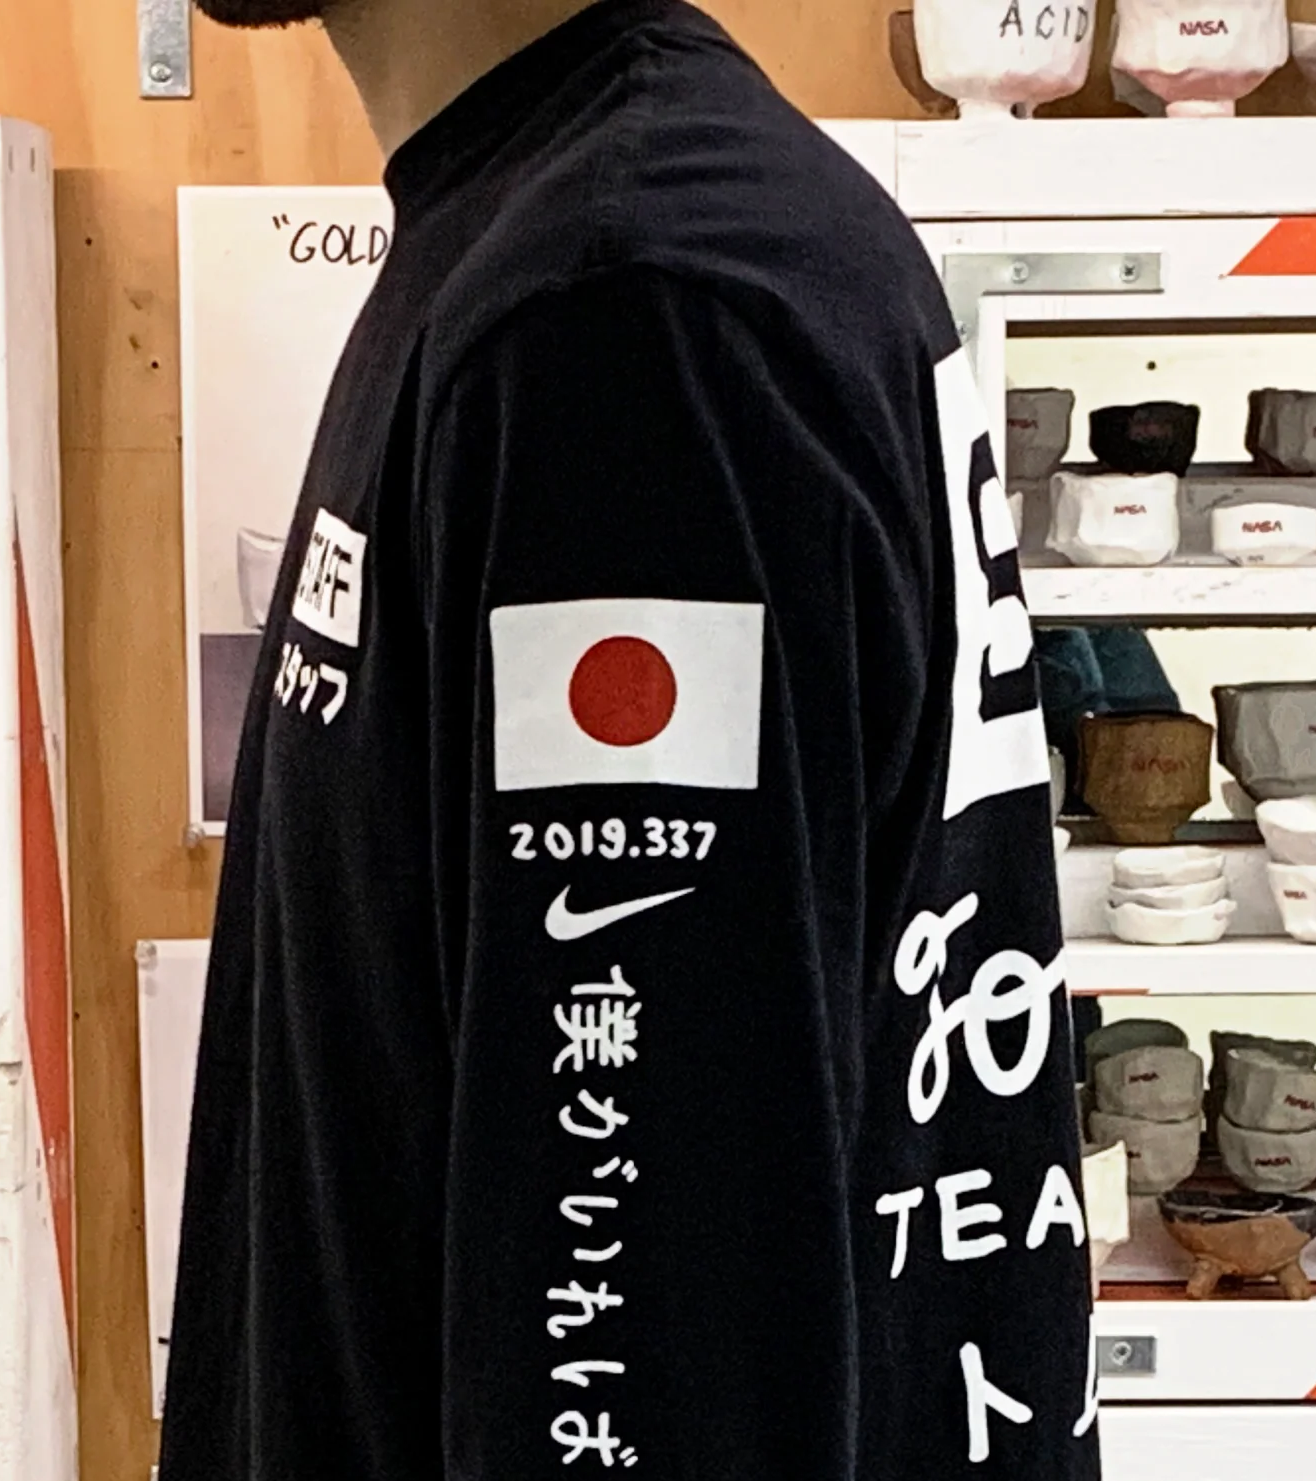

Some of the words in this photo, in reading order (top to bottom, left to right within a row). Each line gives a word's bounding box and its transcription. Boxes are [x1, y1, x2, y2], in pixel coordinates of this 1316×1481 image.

[999, 0, 1090, 43] ACID
[1179, 19, 1229, 36] NASA
[509, 816, 717, 861] 2019.337
